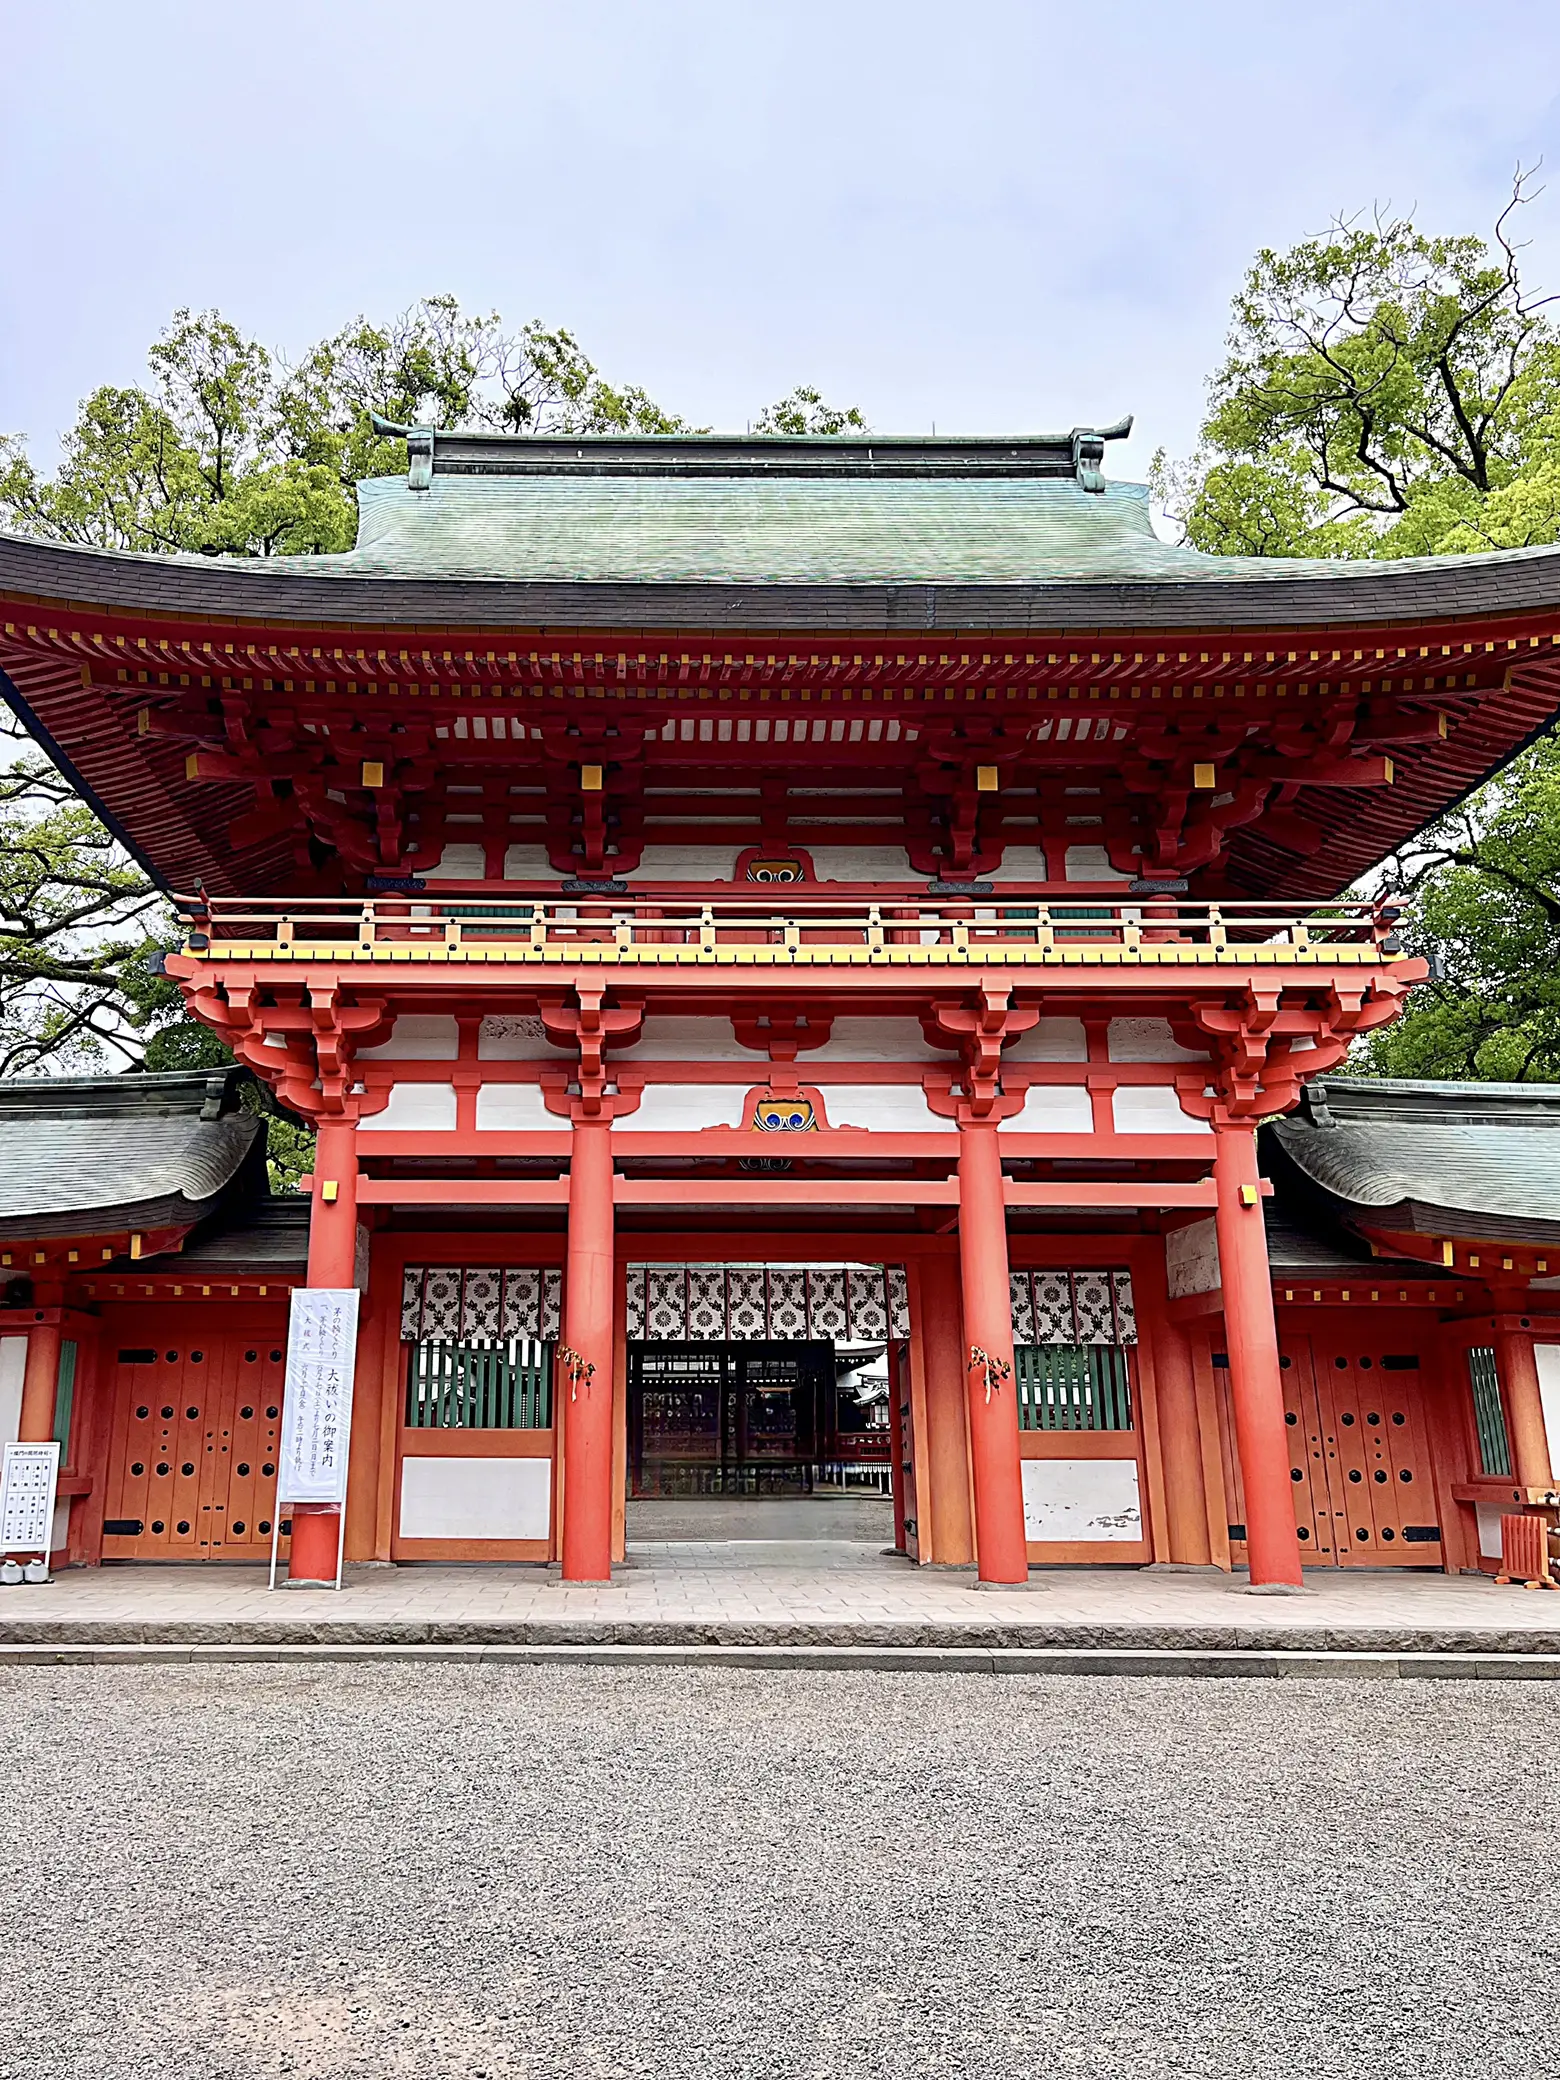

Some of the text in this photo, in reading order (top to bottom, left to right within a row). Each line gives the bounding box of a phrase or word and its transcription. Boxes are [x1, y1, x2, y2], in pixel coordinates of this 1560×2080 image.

[322, 1368, 339, 1467] 大祓いの御案内
